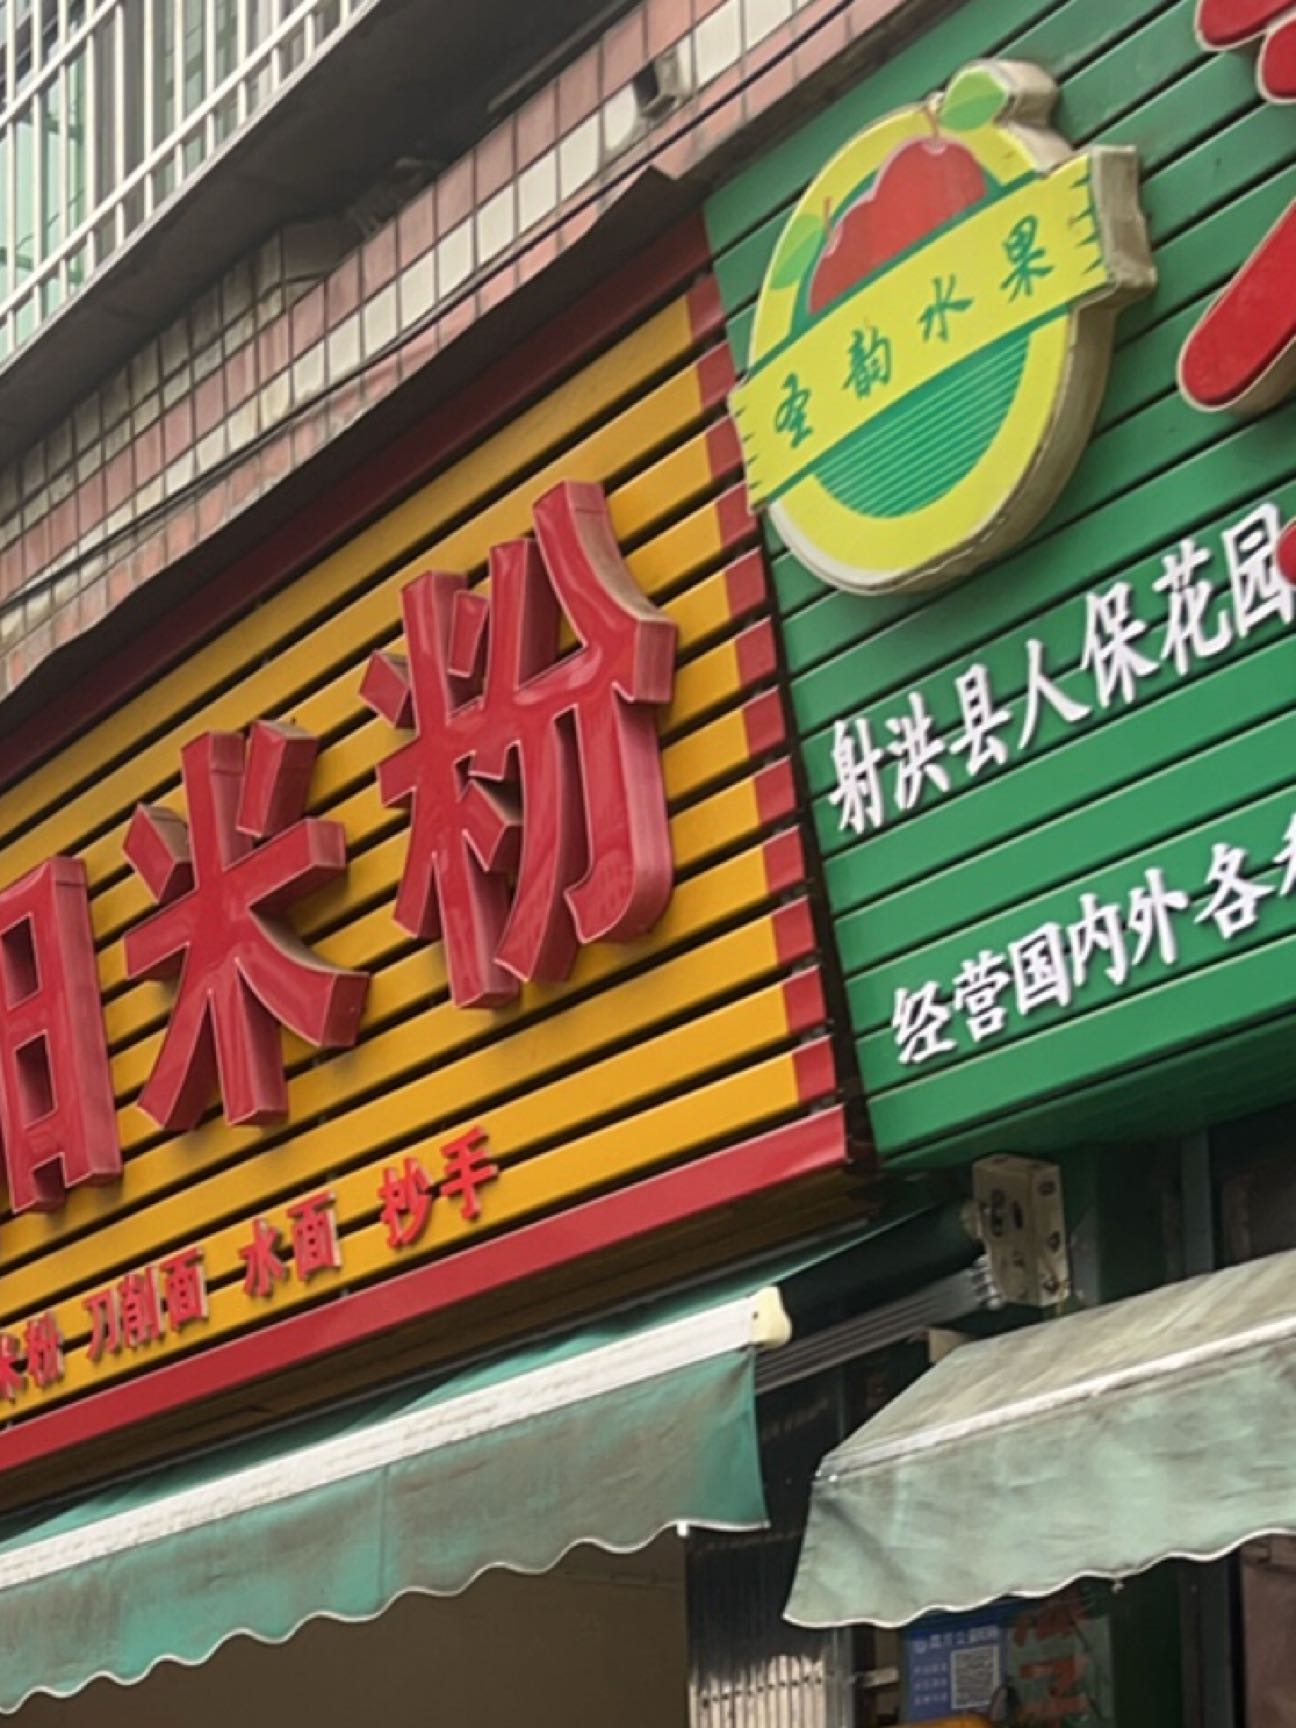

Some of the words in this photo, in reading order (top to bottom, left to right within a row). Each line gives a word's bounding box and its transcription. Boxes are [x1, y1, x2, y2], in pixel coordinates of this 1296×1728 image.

[830, 502, 1296, 833] 射洪县人保花园
[83, 1245, 208, 1362] 刀削面
[239, 1189, 342, 1298] 水面
[378, 1125, 500, 1249] 抄手
